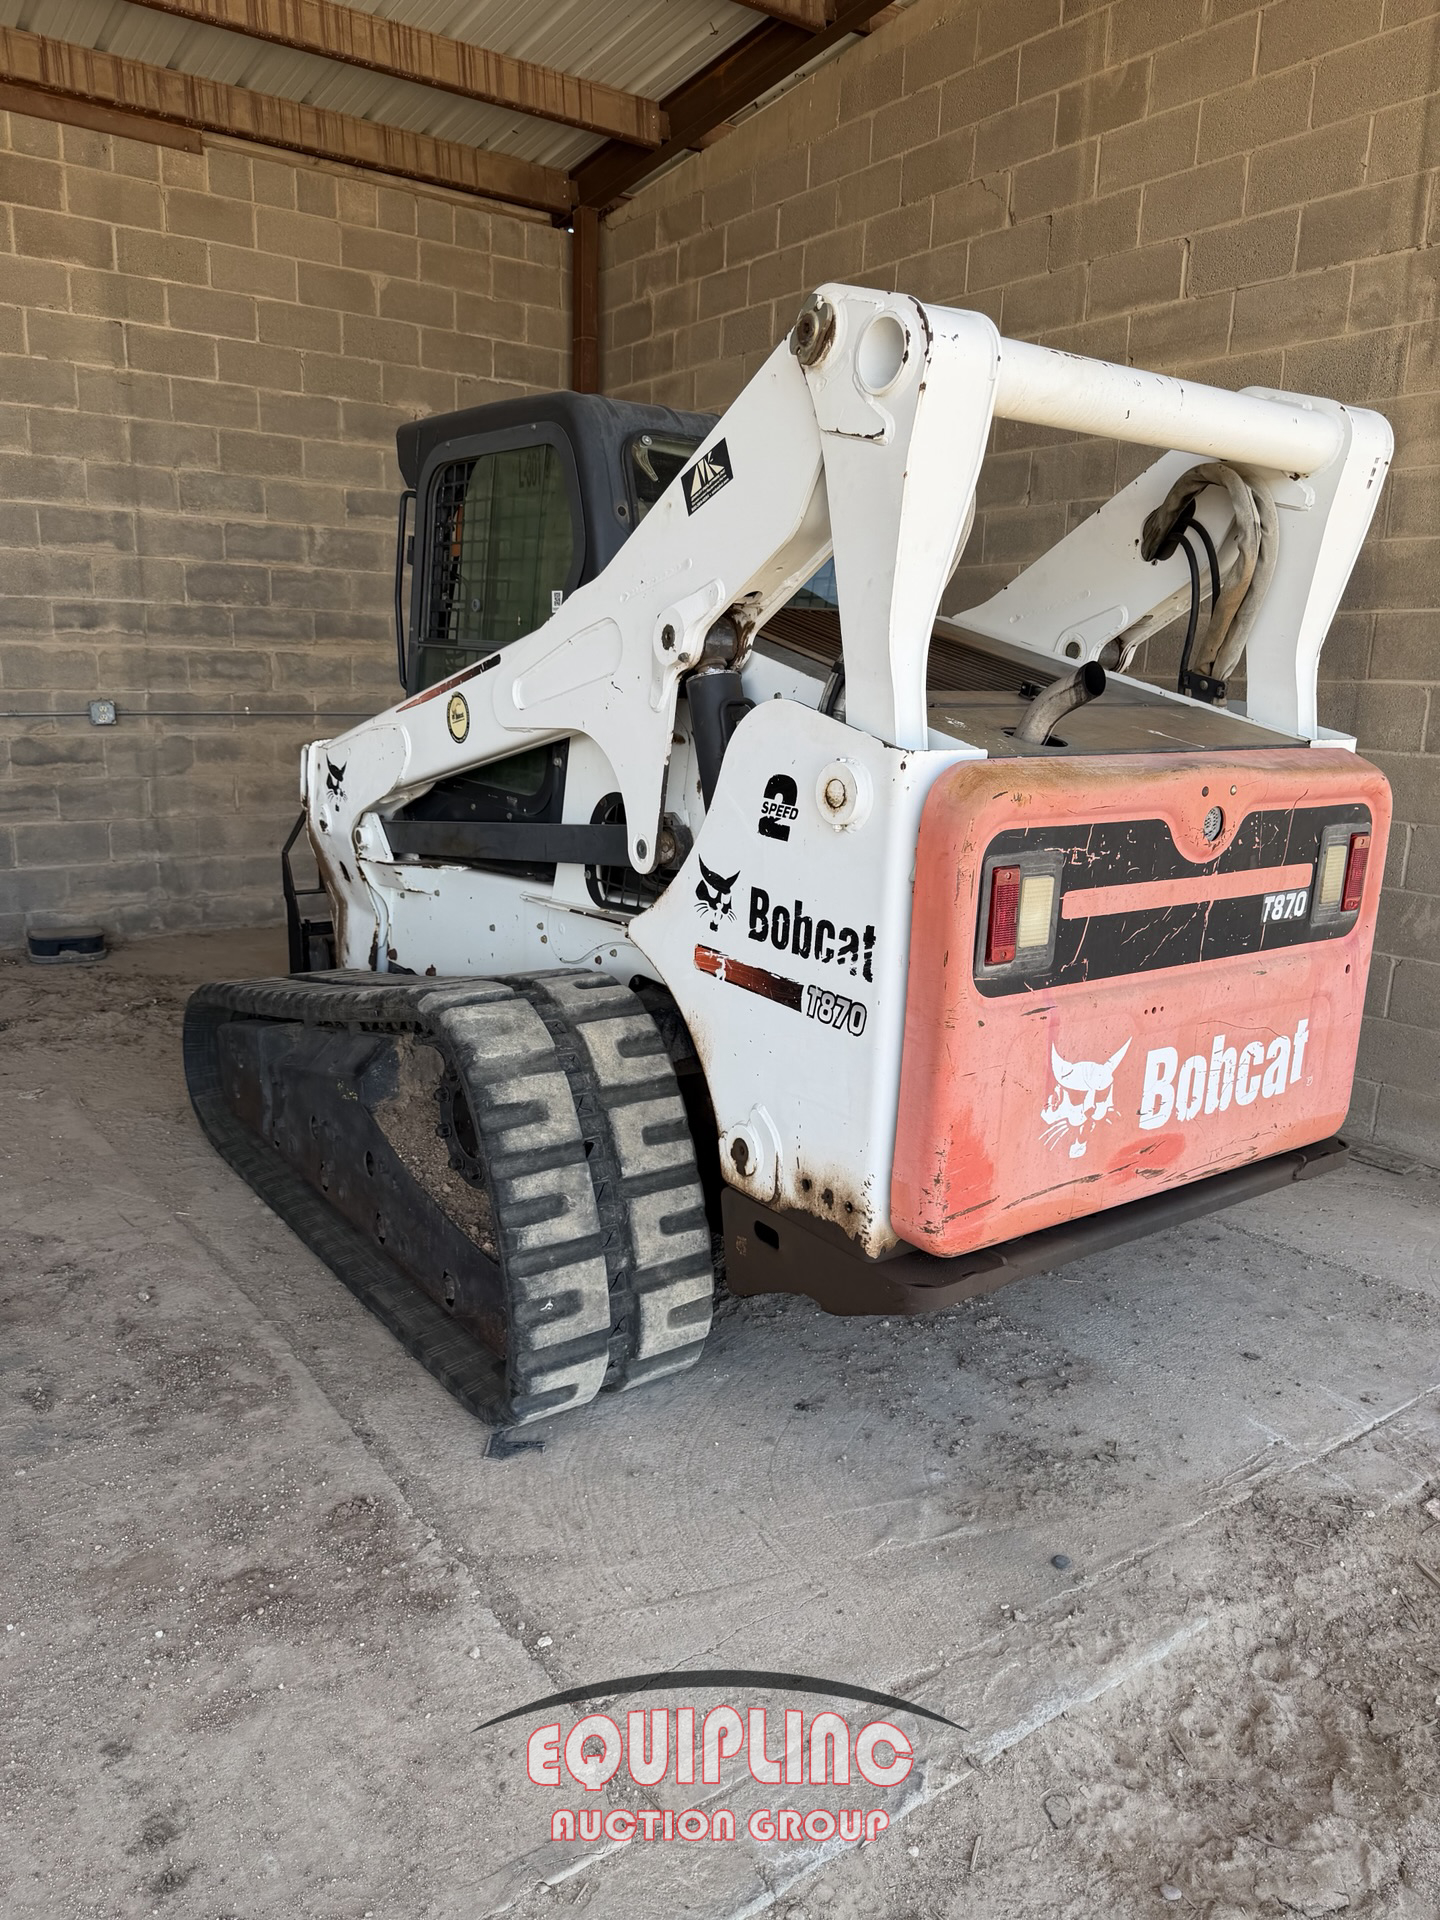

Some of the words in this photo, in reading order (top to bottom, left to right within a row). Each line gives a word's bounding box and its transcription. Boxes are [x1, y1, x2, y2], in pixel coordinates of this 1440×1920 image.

[761, 801, 799, 821] SPEED
[1263, 890, 1308, 923] T870
[748, 886, 877, 983] Bobcat
[807, 984, 868, 1037] T870
[1137, 1018, 1310, 1131] Bobcat
